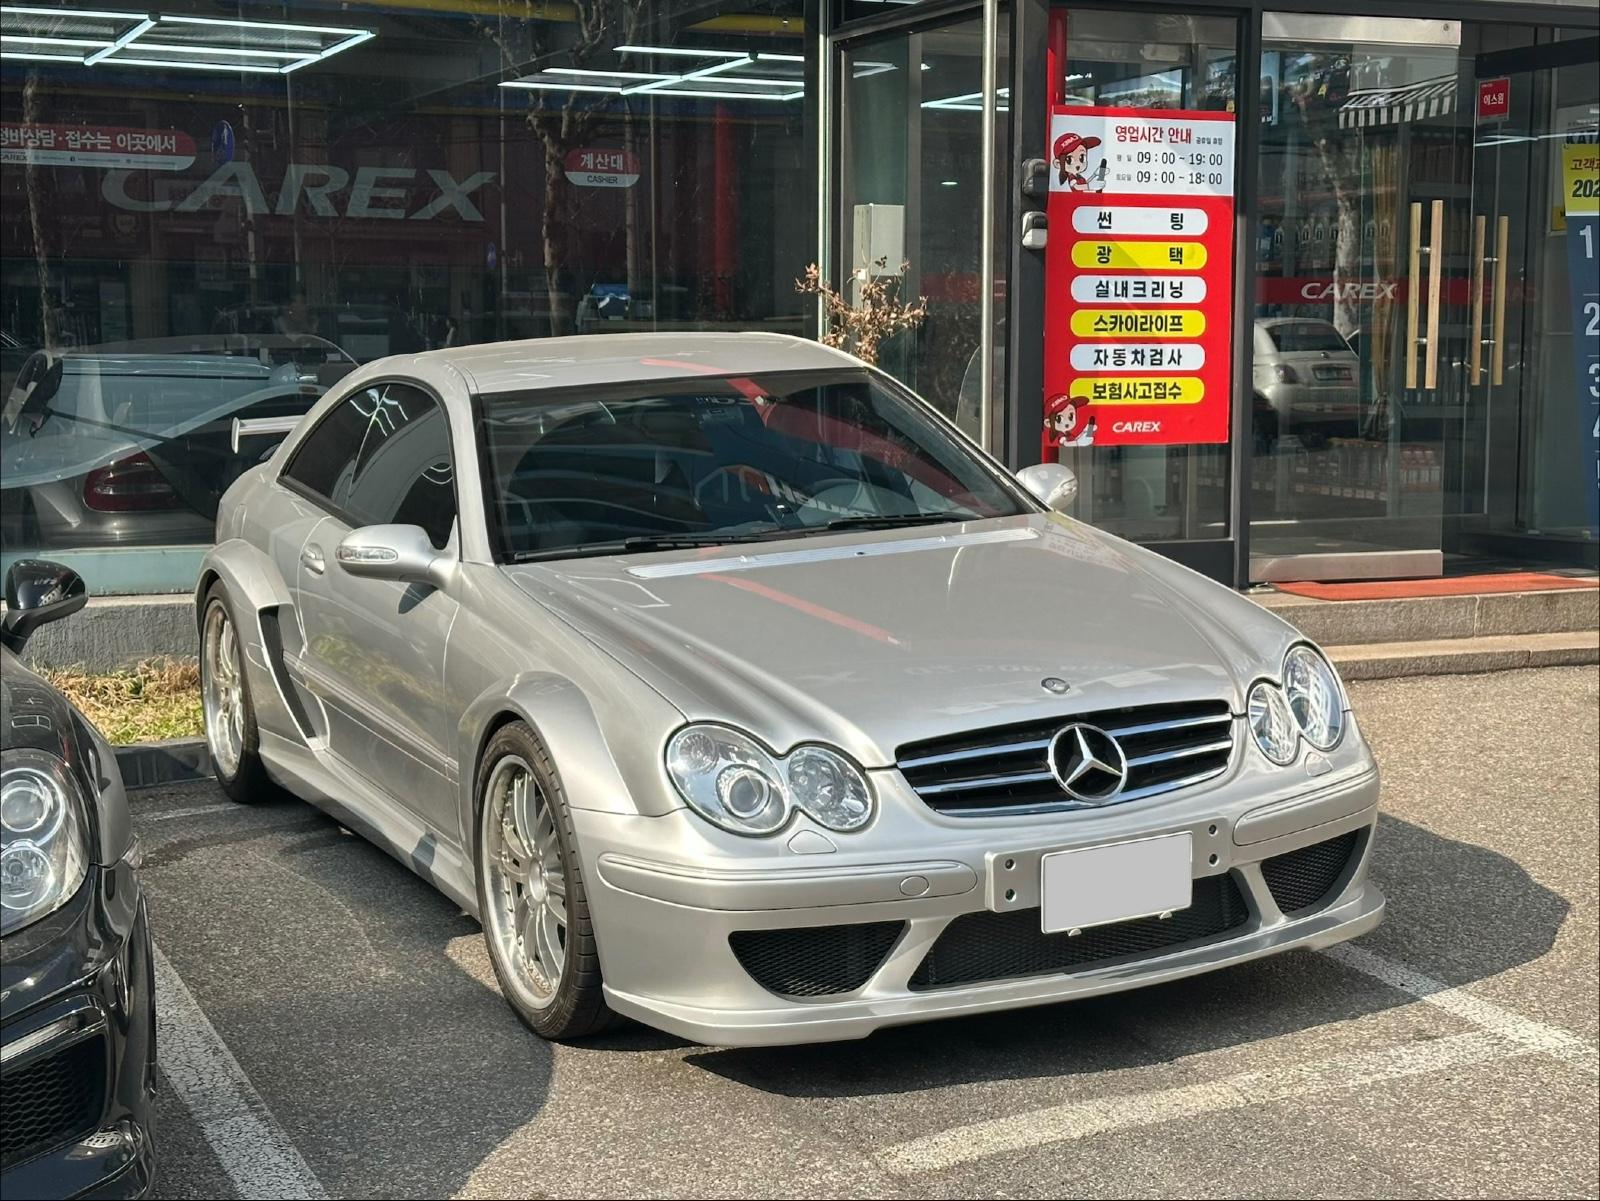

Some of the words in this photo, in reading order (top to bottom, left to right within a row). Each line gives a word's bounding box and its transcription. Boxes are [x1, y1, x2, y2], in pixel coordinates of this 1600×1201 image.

[117, 133, 176, 152] 이곳에서
[1115, 125, 1164, 143] 영업시간
[1168, 127, 1192, 144] 안내
[580, 152, 623, 170] 계산대
[1570, 157, 1599, 172] 고객
[586, 175, 618, 184] CASHIER
[101, 160, 499, 222] CAREX
[1579, 224, 1593, 259] 1
[1095, 280, 1184, 299] 실내크리닝
[1301, 282, 1399, 300] CAREX
[1093, 314, 1184, 332] 스카이라이프
[1583, 301, 1599, 336] 2
[1093, 348, 1183, 366] 자동차검사
[1092, 382, 1182, 400] 보험사고접수
[1112, 421, 1161, 433] CAREX
